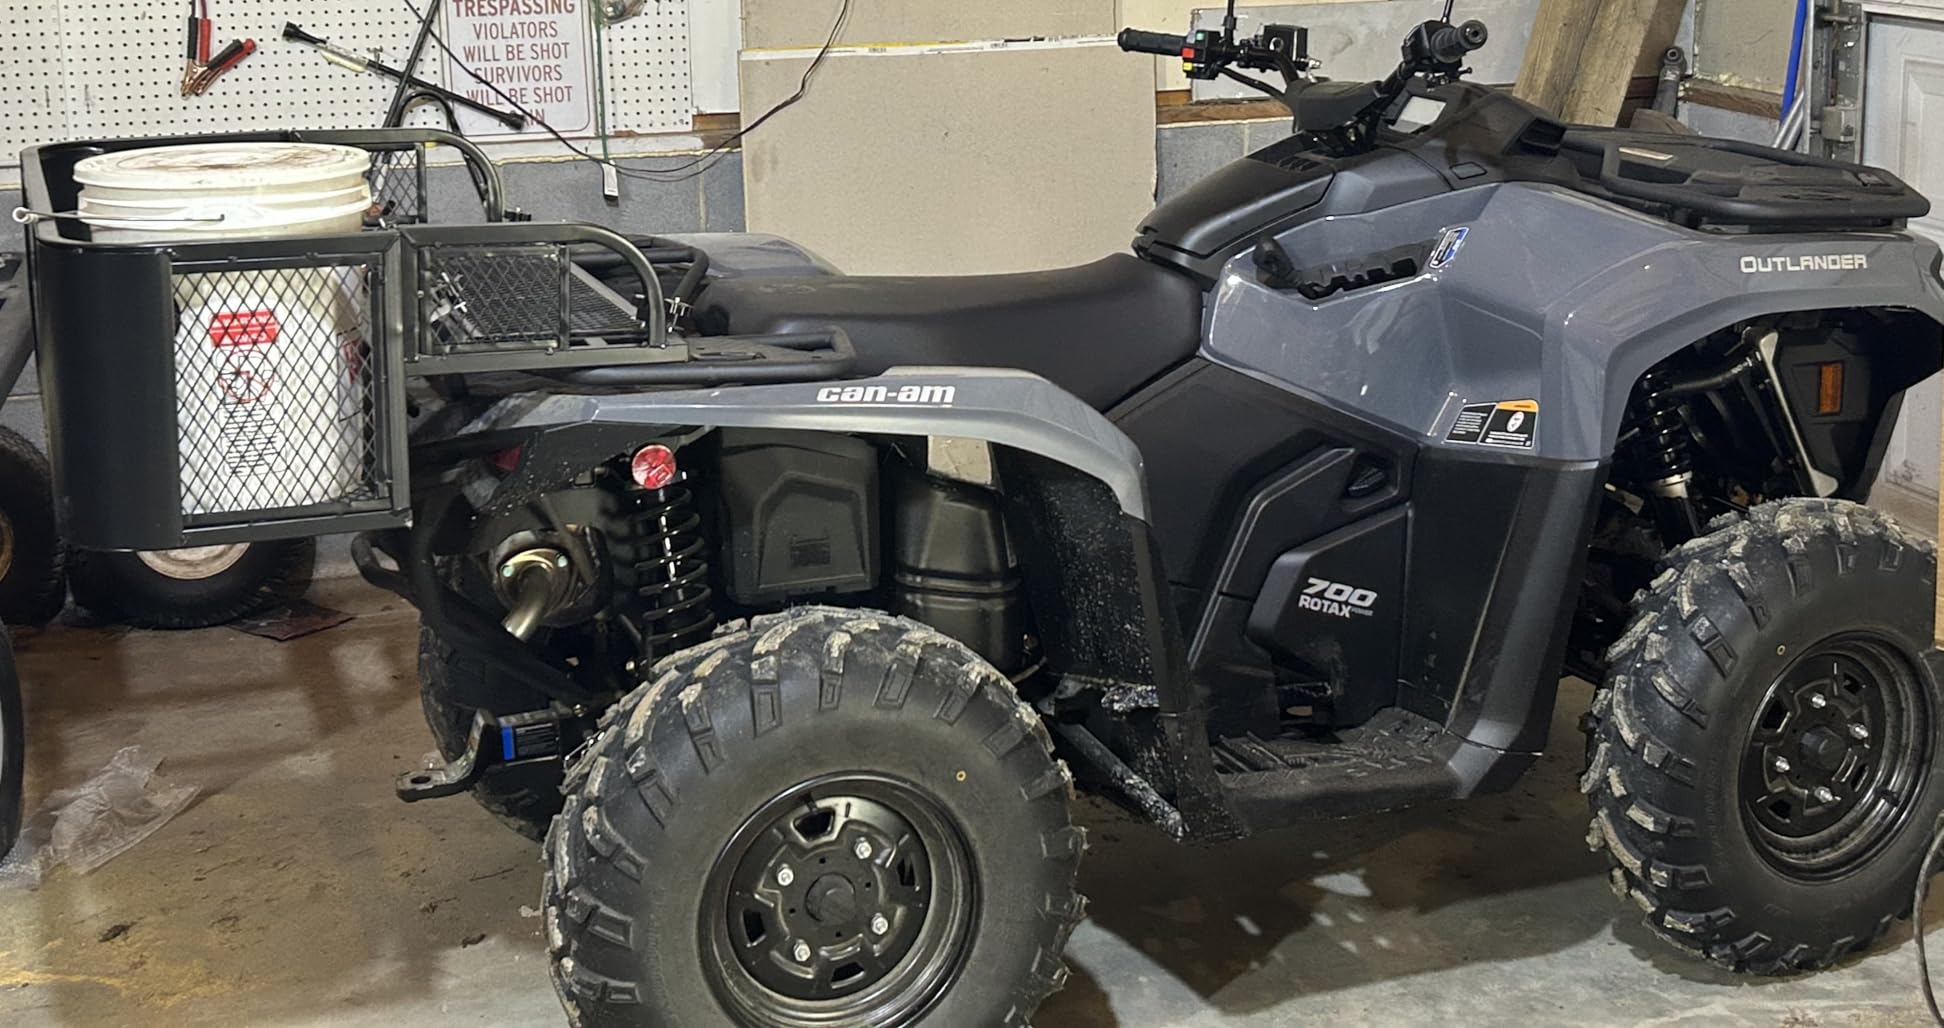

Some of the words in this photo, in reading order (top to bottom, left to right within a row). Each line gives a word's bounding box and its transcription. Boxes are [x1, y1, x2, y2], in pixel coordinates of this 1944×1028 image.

[454, 0, 575, 17] TRESPASSING
[473, 21, 558, 40] VIOLATORS
[463, 45, 501, 62] WILL
[506, 44, 525, 61] BE
[530, 42, 570, 60] SHOT
[474, 64, 563, 84] SURVIVORS
[466, 89, 504, 106] WILL
[508, 88, 528, 104] BE
[533, 86, 573, 103] SHOT
[1740, 253, 1868, 273] OUTLANDER
[816, 385, 956, 403] can-am
[1303, 577, 1377, 607] 700
[1298, 595, 1352, 618] ROTAX
